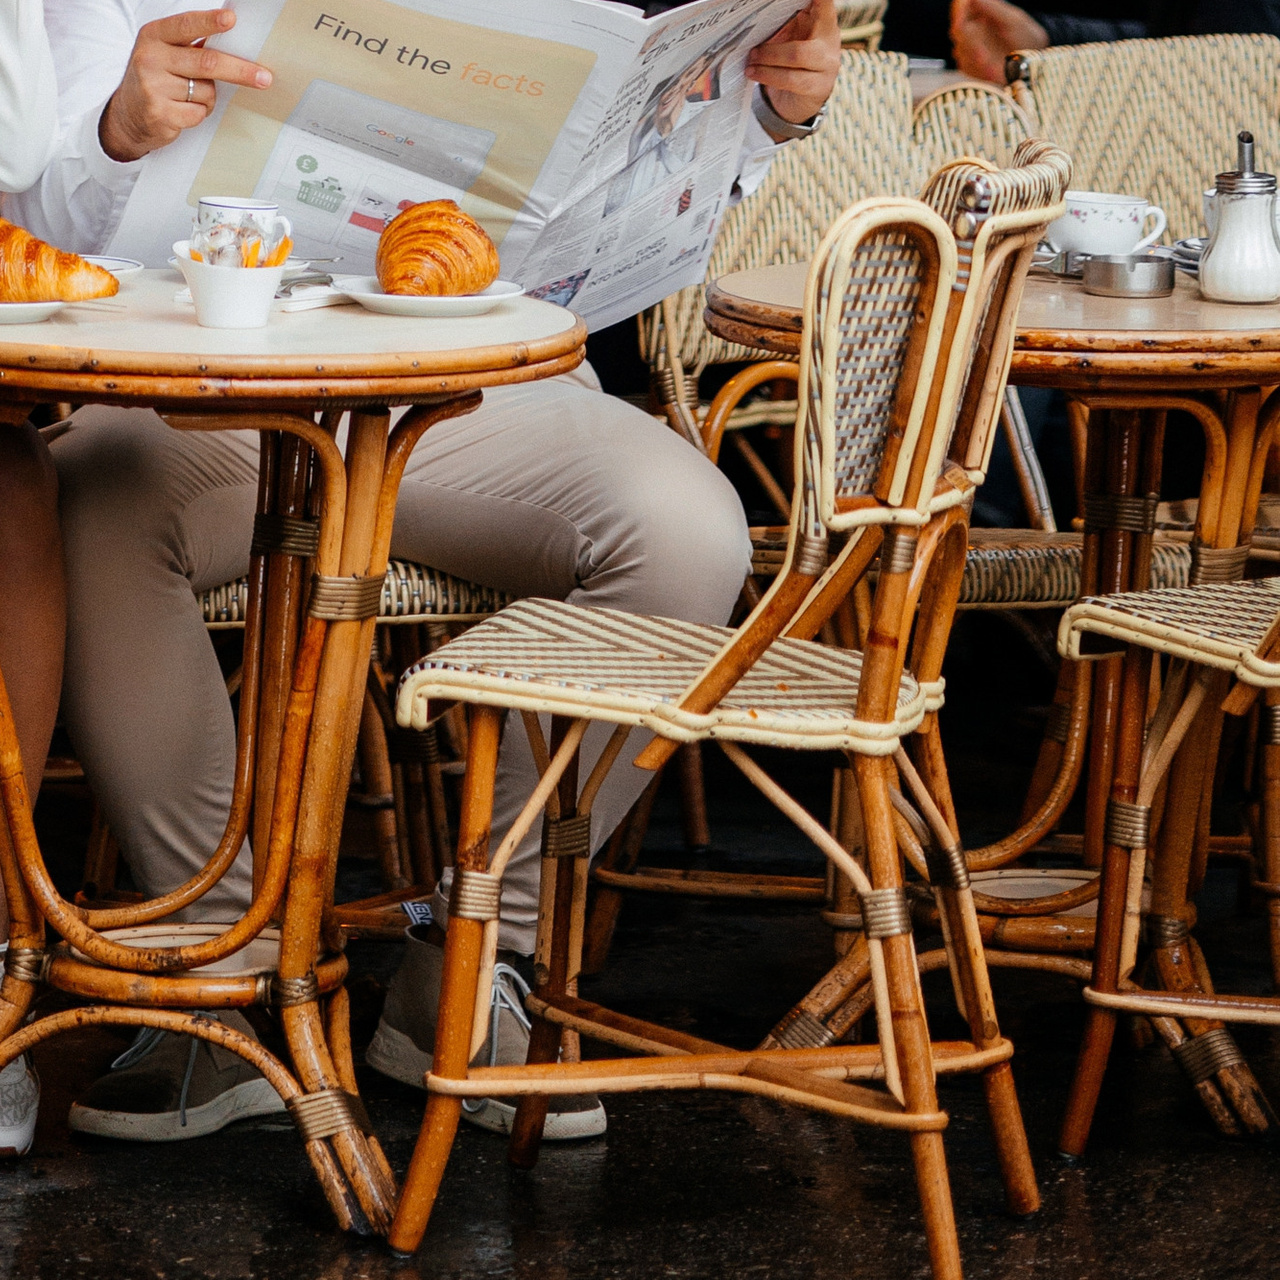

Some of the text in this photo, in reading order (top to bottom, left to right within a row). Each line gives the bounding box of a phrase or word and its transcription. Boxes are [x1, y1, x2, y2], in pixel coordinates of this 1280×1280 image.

[313, 13, 546, 97] Find the facts
[366, 123, 415, 146] Google
